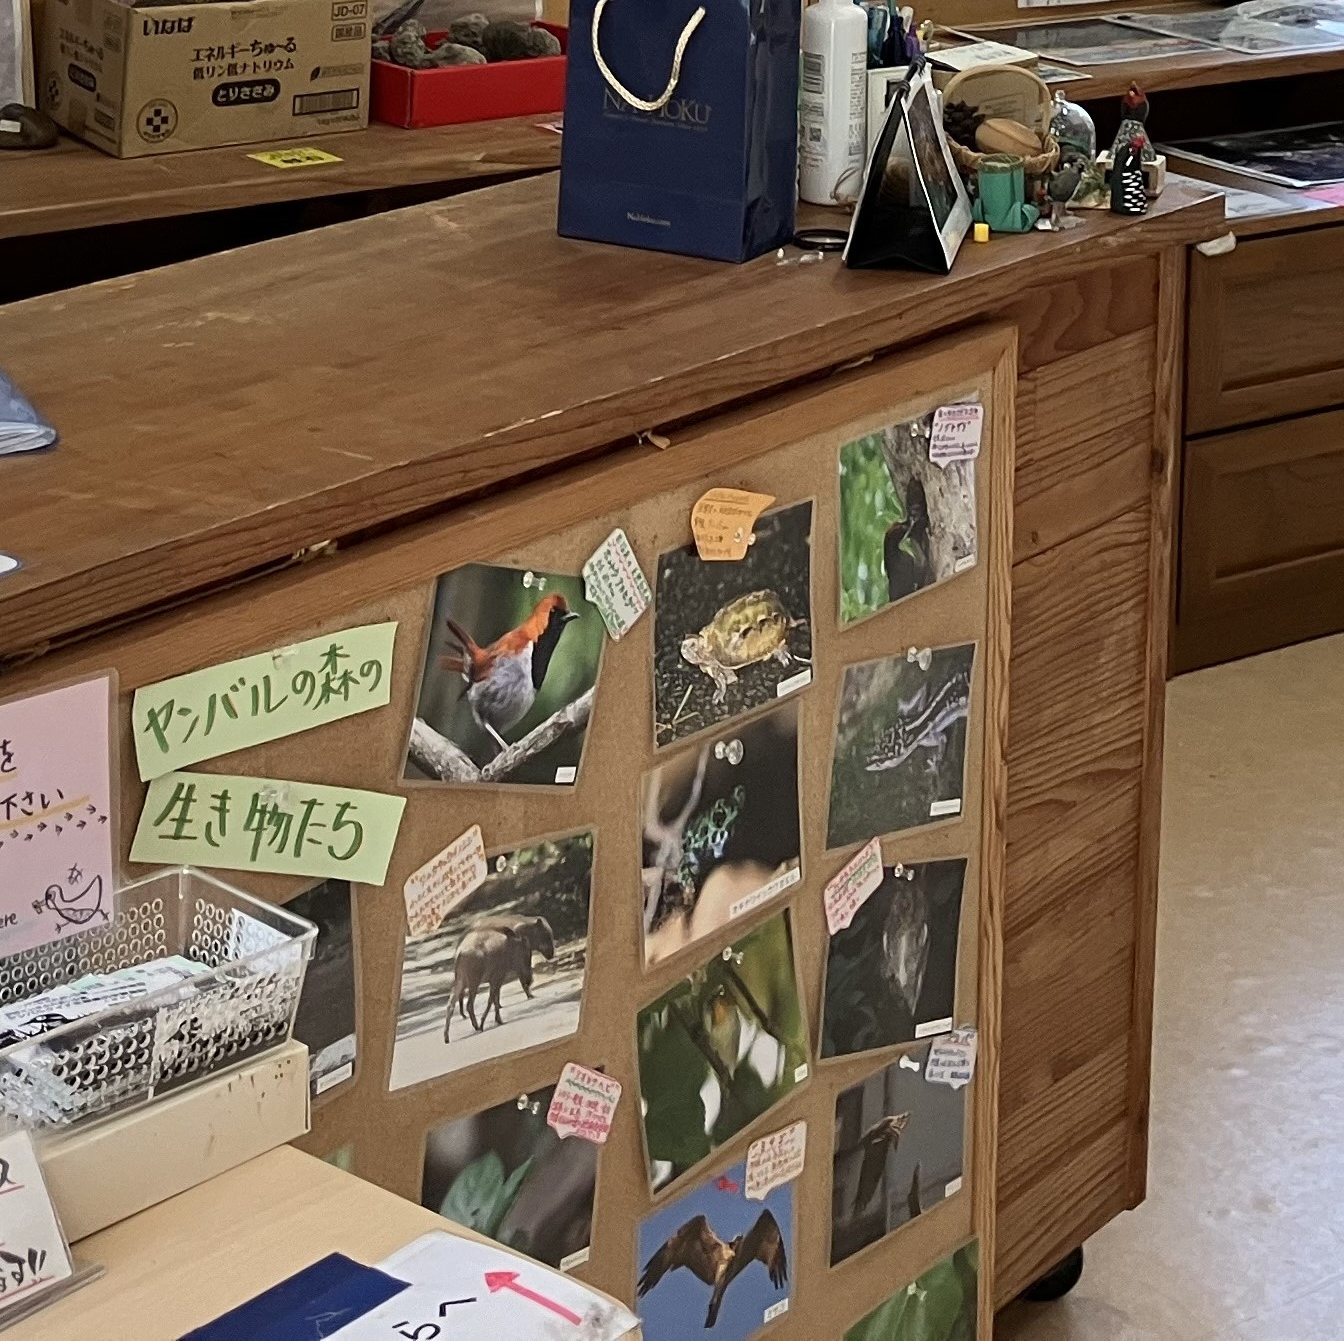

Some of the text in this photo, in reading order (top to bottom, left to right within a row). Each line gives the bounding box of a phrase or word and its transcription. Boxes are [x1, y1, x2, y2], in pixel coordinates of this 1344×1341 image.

[142, 15, 197, 36] いなば
[192, 59, 295, 81] 低リン低ナトリウム
[216, 82, 276, 101] とりささみ
[144, 642, 383, 754] ヤンバルの森の
[156, 780, 363, 861] 生き物たち
